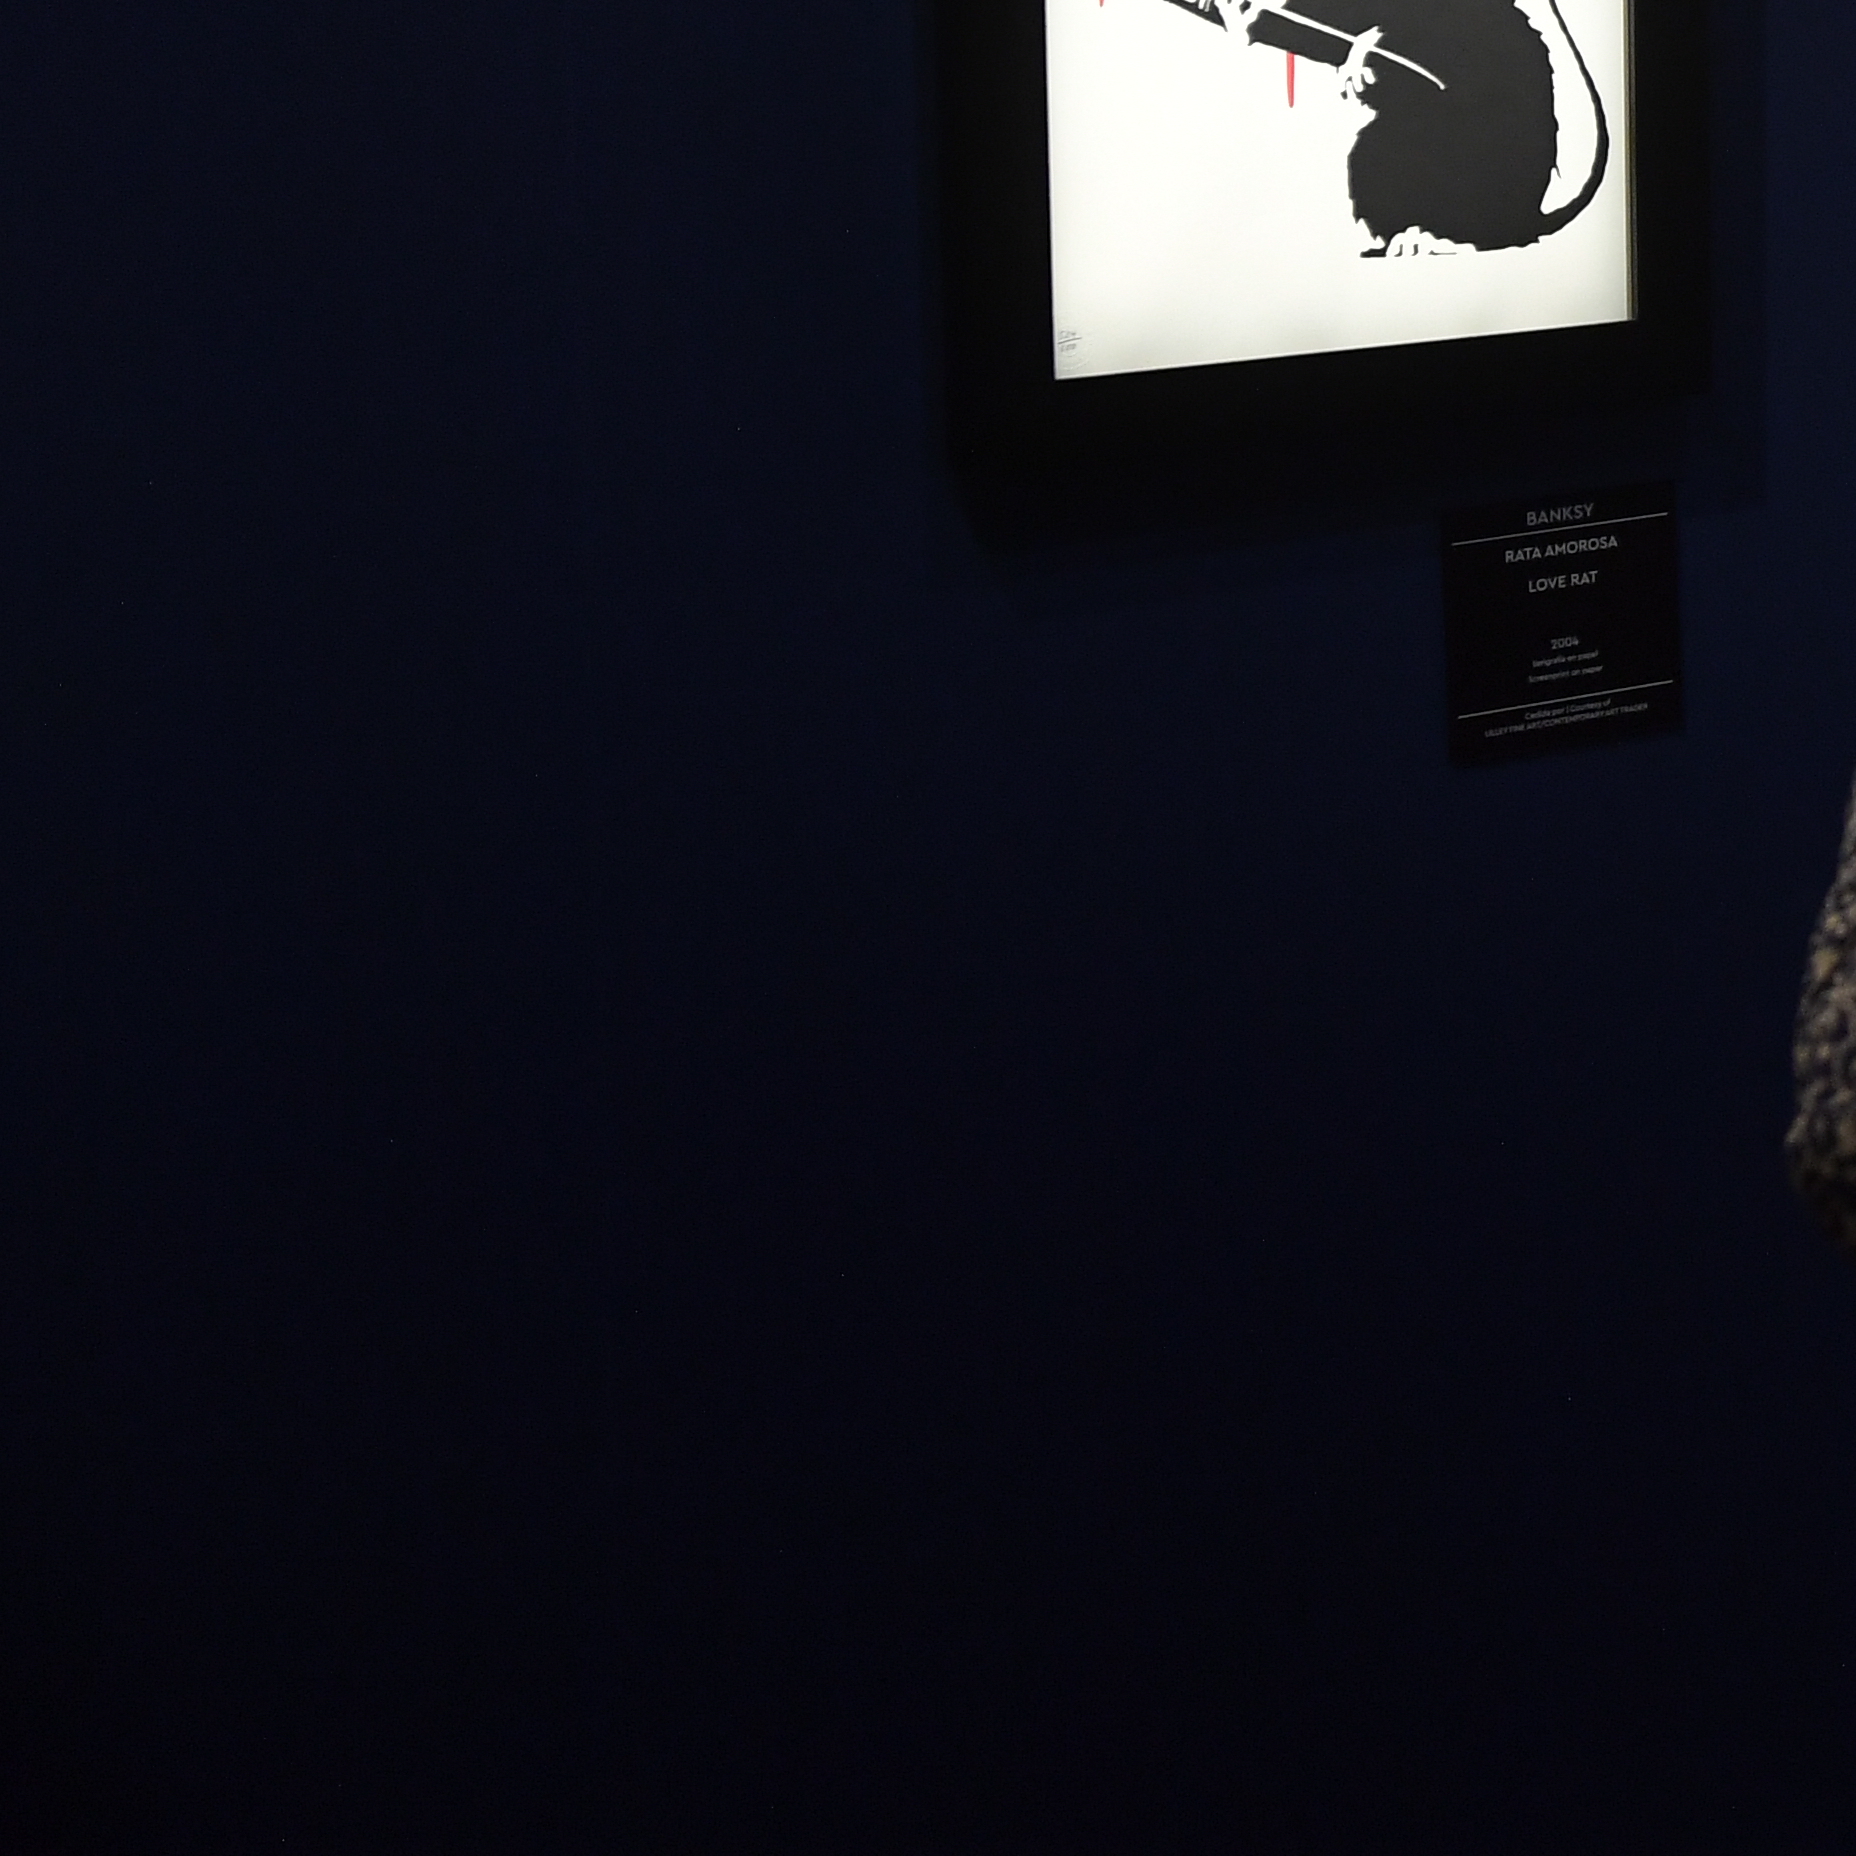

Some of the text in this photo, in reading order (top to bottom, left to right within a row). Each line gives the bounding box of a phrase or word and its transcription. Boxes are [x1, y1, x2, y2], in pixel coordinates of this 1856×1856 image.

[1526, 503, 1594, 526] BANKSY
[1505, 535, 1618, 563] RATA AMOROSA
[1528, 570, 1598, 593] LOVE RAT
[1551, 636, 1579, 650] 2004
